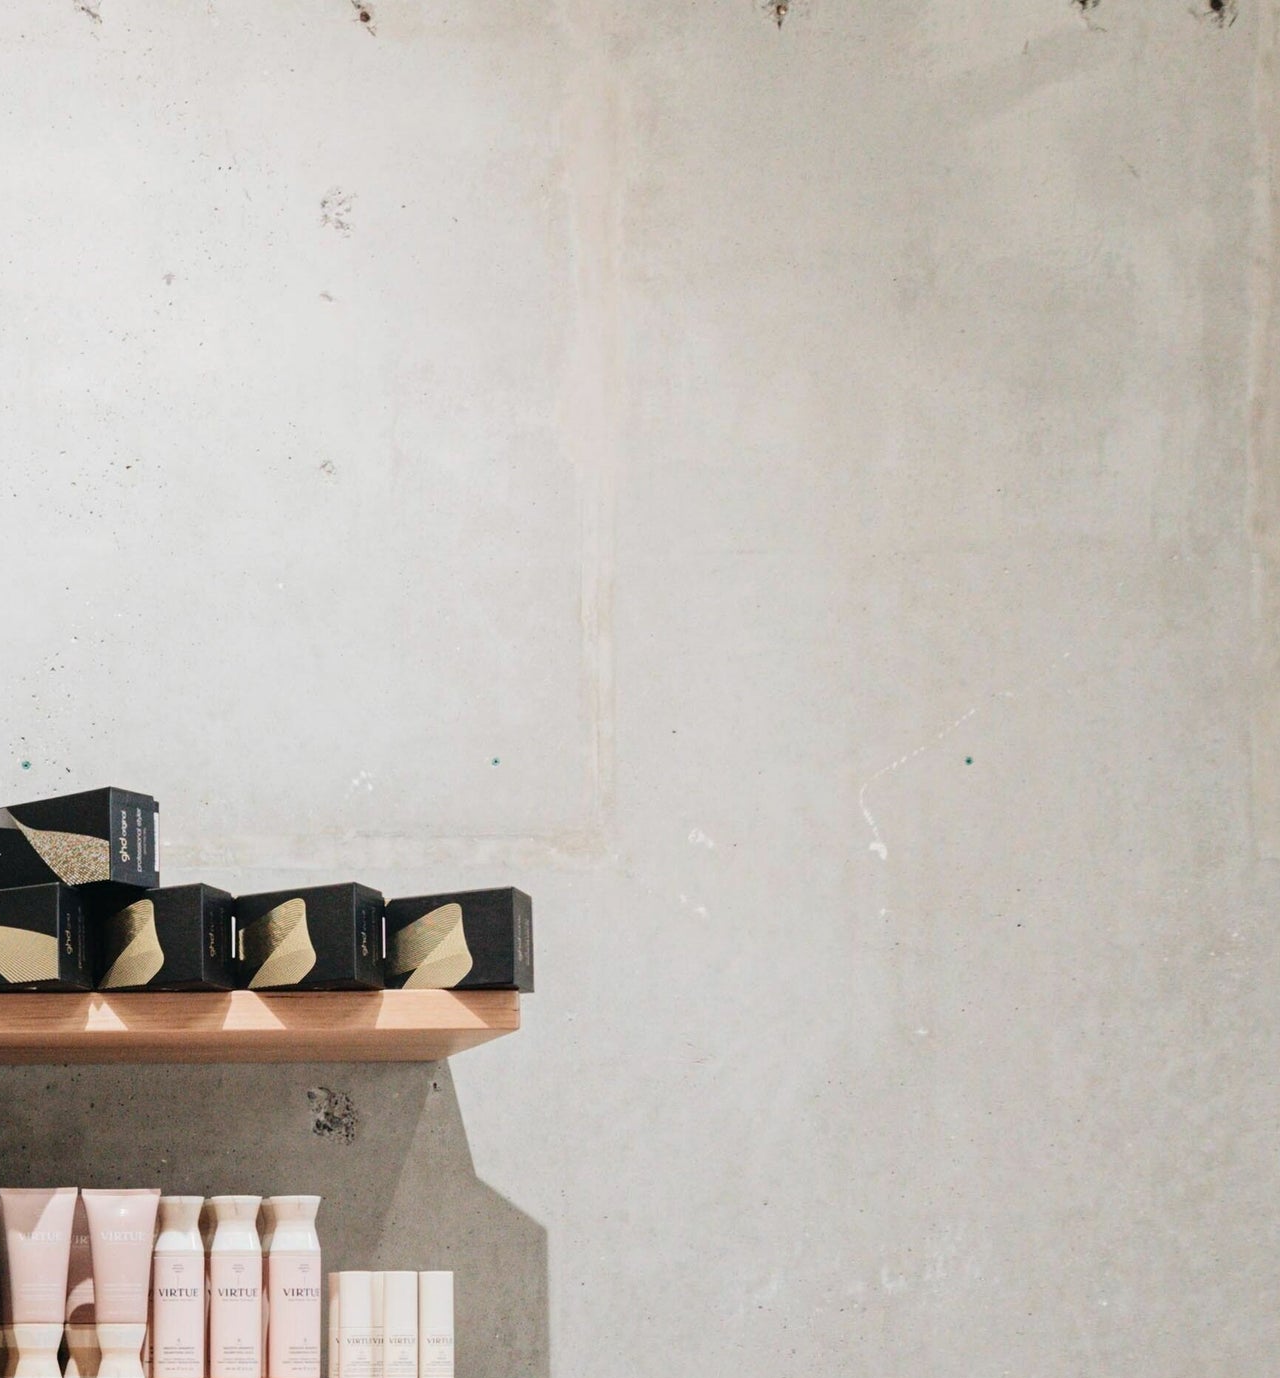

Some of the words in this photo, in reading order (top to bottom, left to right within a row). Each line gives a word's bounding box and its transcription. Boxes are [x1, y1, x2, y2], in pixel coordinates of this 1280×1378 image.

[119, 837, 130, 862] ghd
[101, 1232, 146, 1242] VIRTUE
[158, 1288, 199, 1298] VIRTUE
[218, 1288, 258, 1298] VIRTUE
